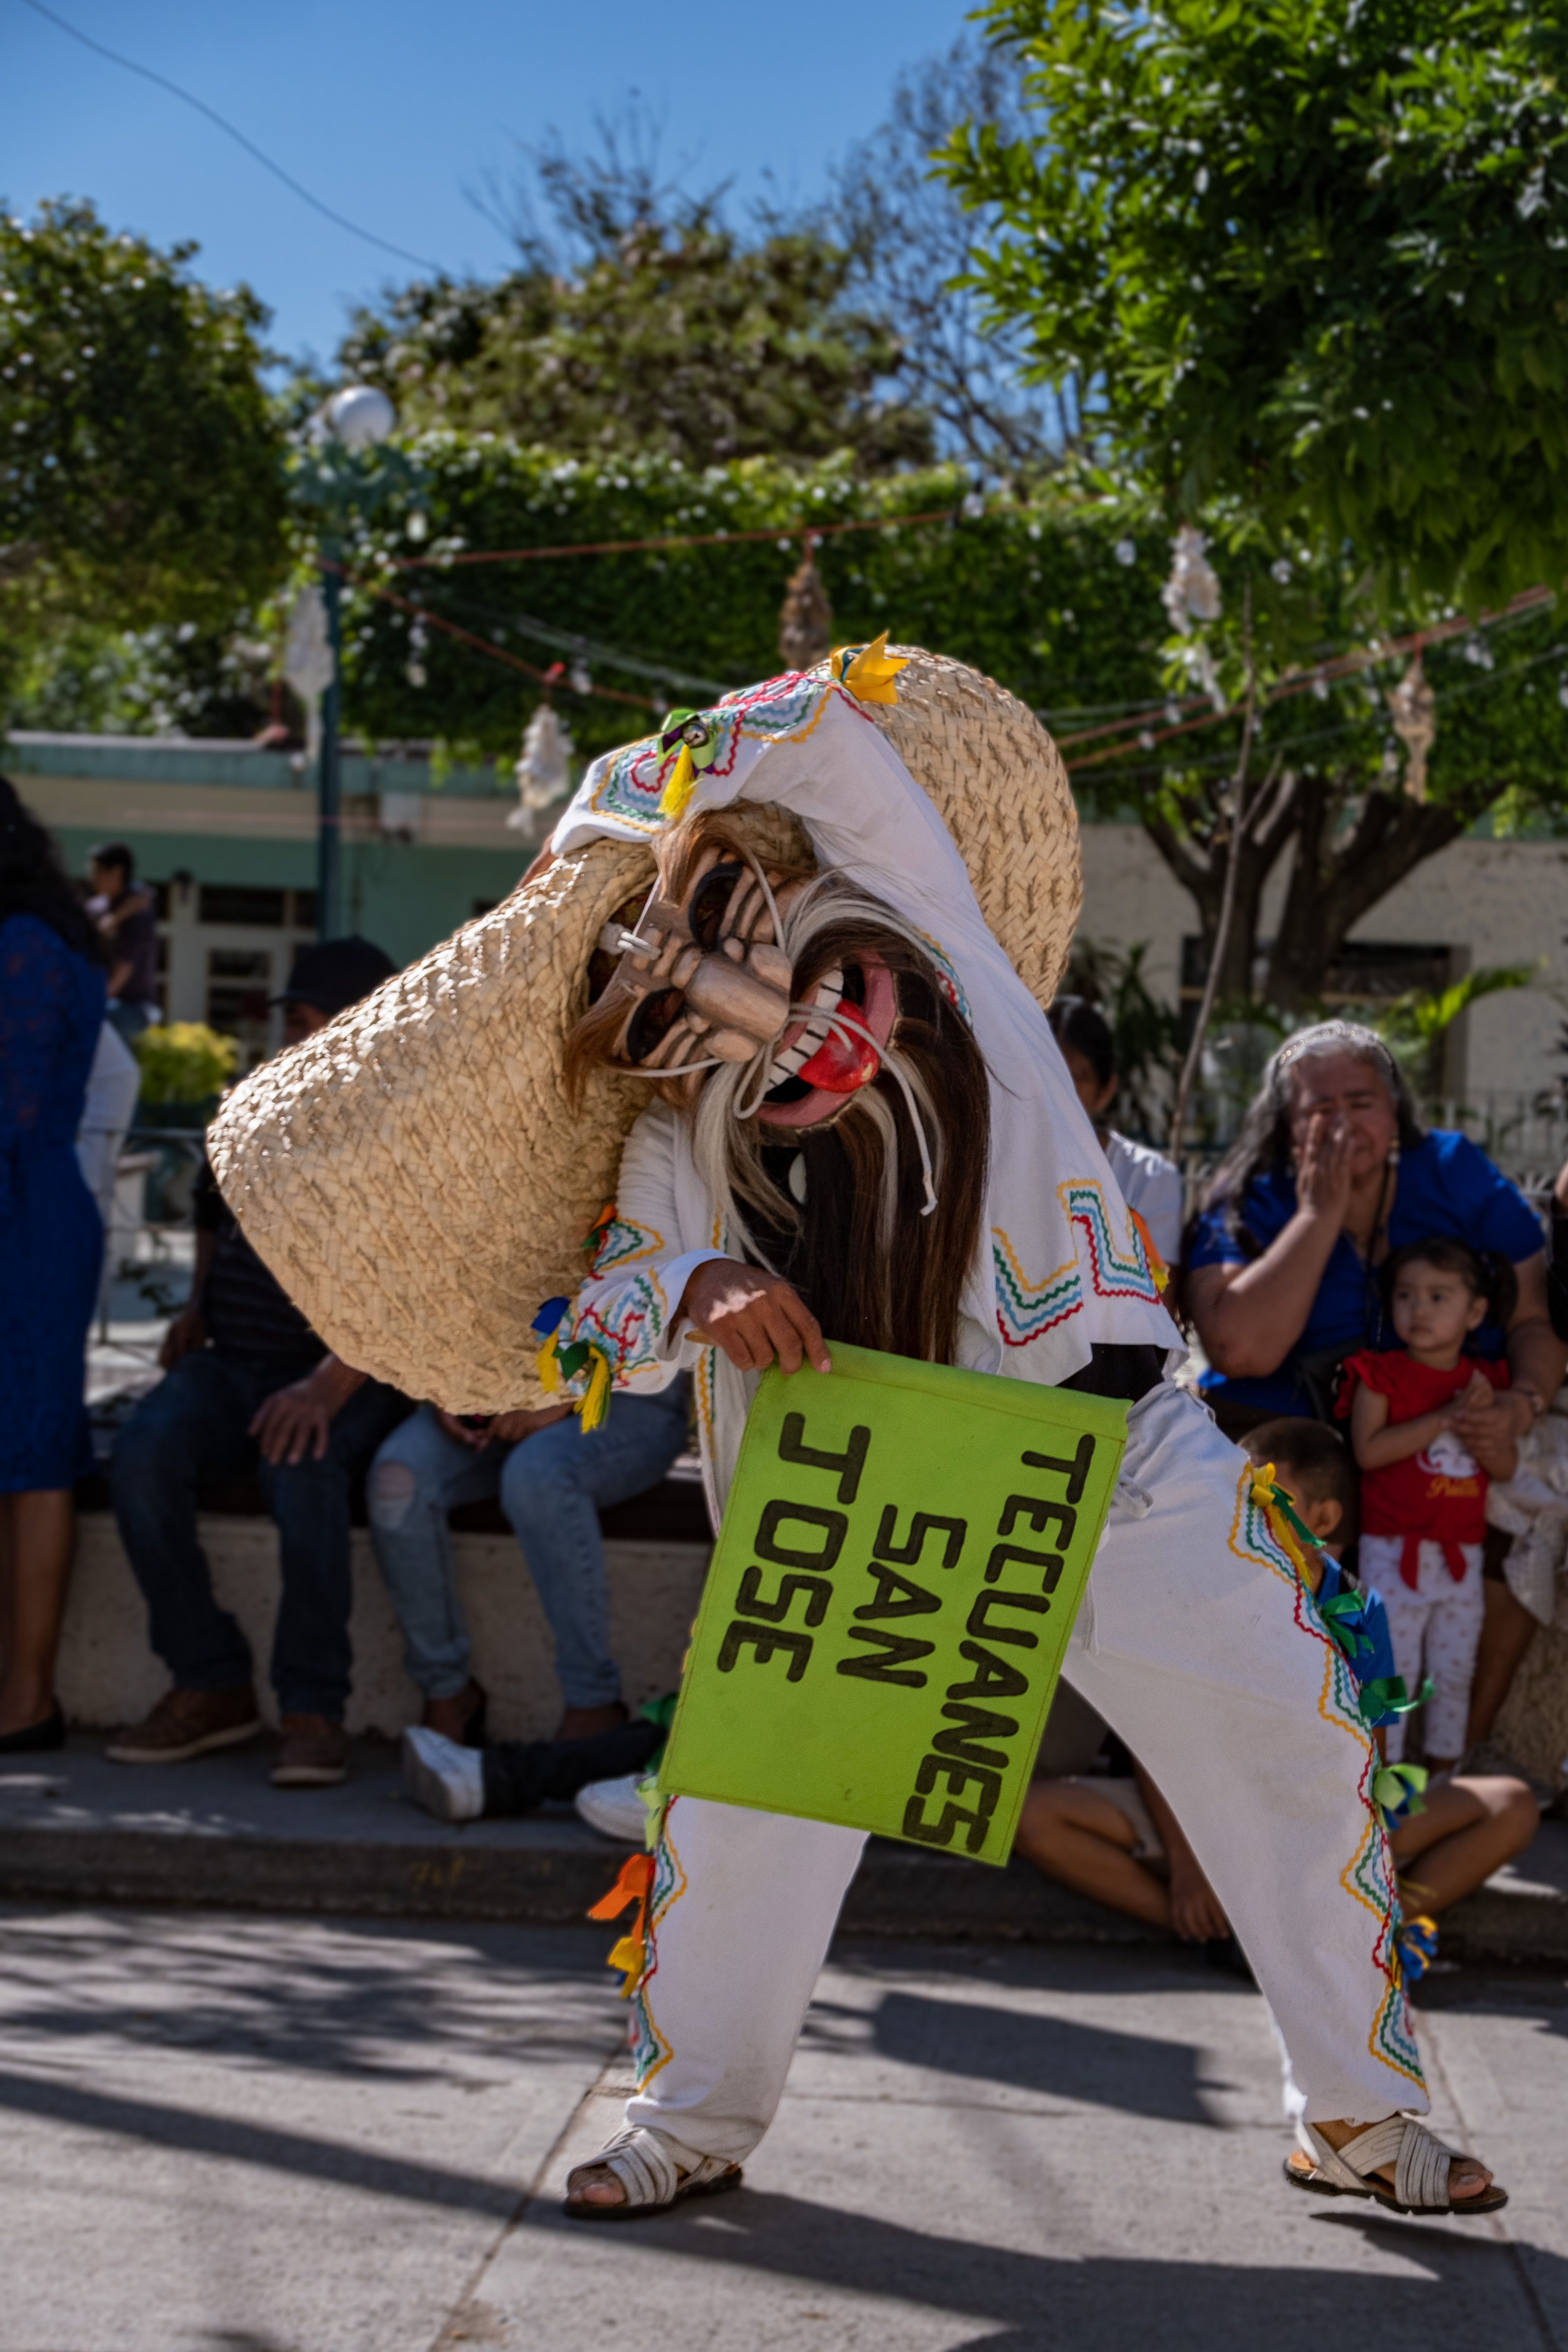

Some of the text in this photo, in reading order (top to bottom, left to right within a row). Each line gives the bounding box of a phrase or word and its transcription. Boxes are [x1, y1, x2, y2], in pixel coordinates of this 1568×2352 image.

[717, 1412, 871, 1683] JOSE
[836, 1504, 968, 1688] SAN
[901, 1433, 1096, 1851] TECUANES
